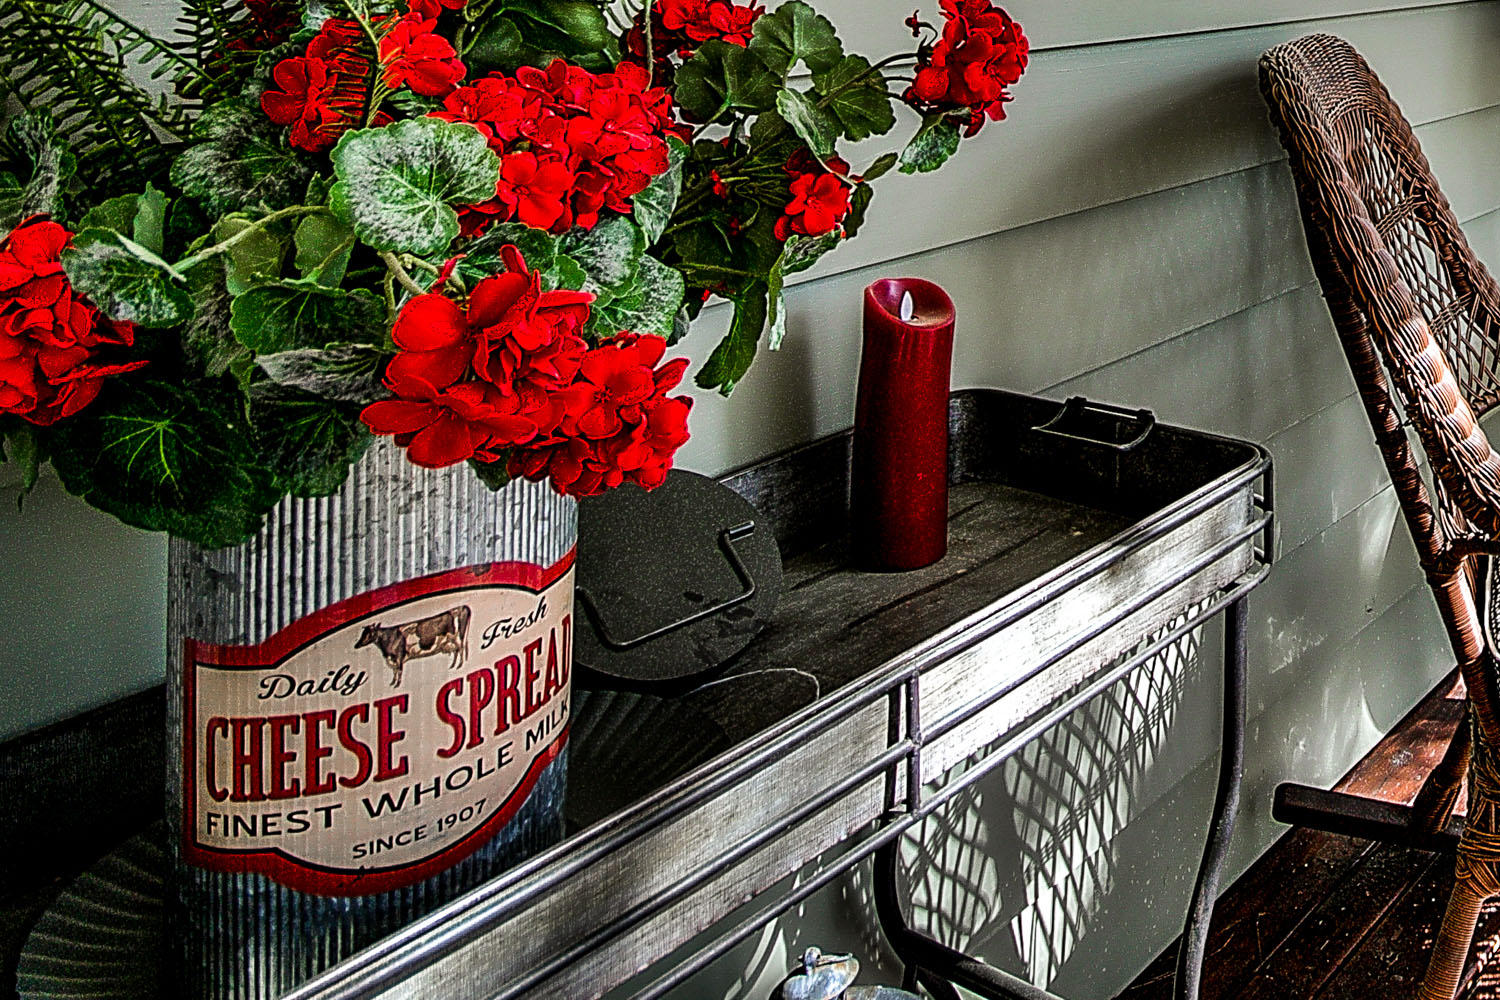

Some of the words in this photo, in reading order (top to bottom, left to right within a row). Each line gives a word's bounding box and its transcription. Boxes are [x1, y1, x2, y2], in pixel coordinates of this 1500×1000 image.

[206, 693, 410, 802] CHEESE
[436, 613, 571, 758] SPREAD
[257, 664, 368, 700] Daily
[481, 596, 549, 649] Fresh
[206, 804, 342, 837] FINEST
[361, 741, 514, 818] WHOLE
[526, 692, 568, 752] MILK
[352, 824, 428, 859] SINCE
[435, 799, 487, 834] 1907
